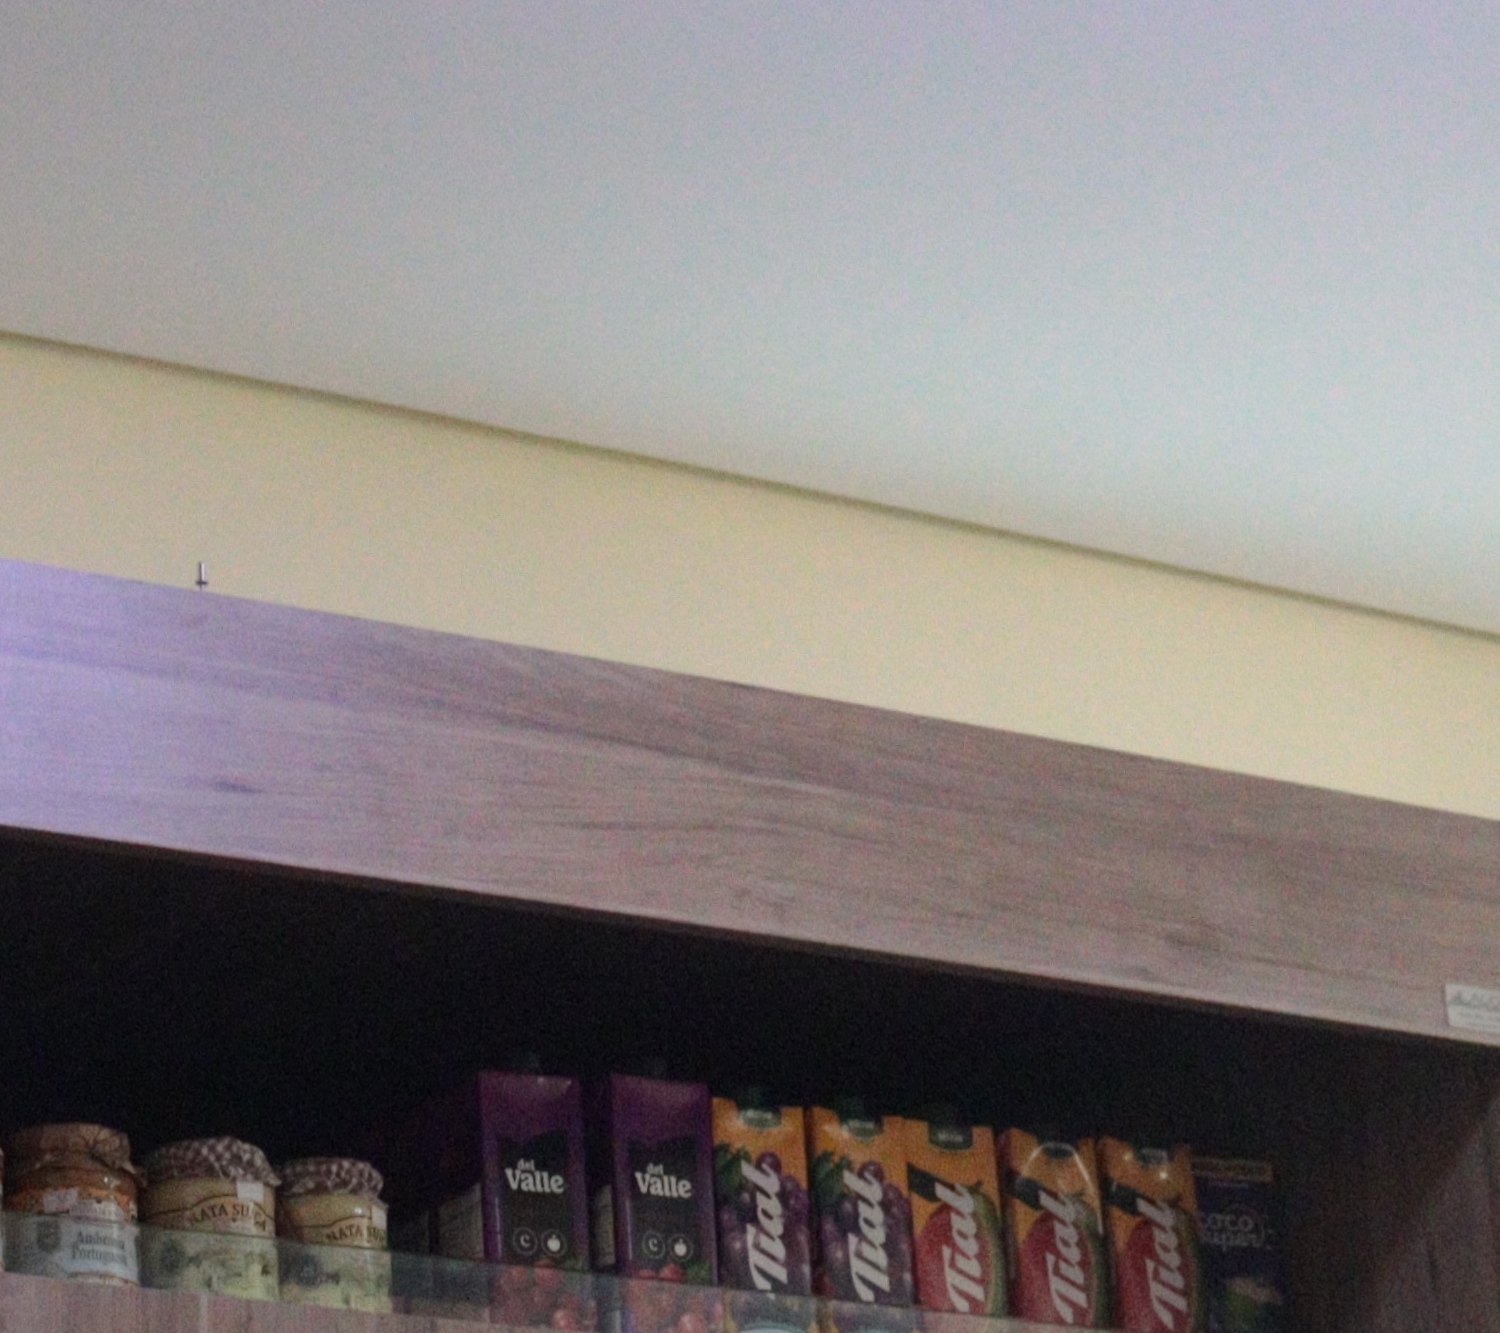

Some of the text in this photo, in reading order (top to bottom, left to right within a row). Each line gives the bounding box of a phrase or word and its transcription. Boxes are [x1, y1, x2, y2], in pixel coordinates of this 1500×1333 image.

[504, 1167, 565, 1194] Valle
[634, 1171, 693, 1199] Valle
[741, 1159, 788, 1298] Tial
[842, 1167, 890, 1303] Tial
[934, 1181, 985, 1312] Tial
[1040, 1187, 1088, 1324] Tial
[1137, 1195, 1188, 1331] Tial
